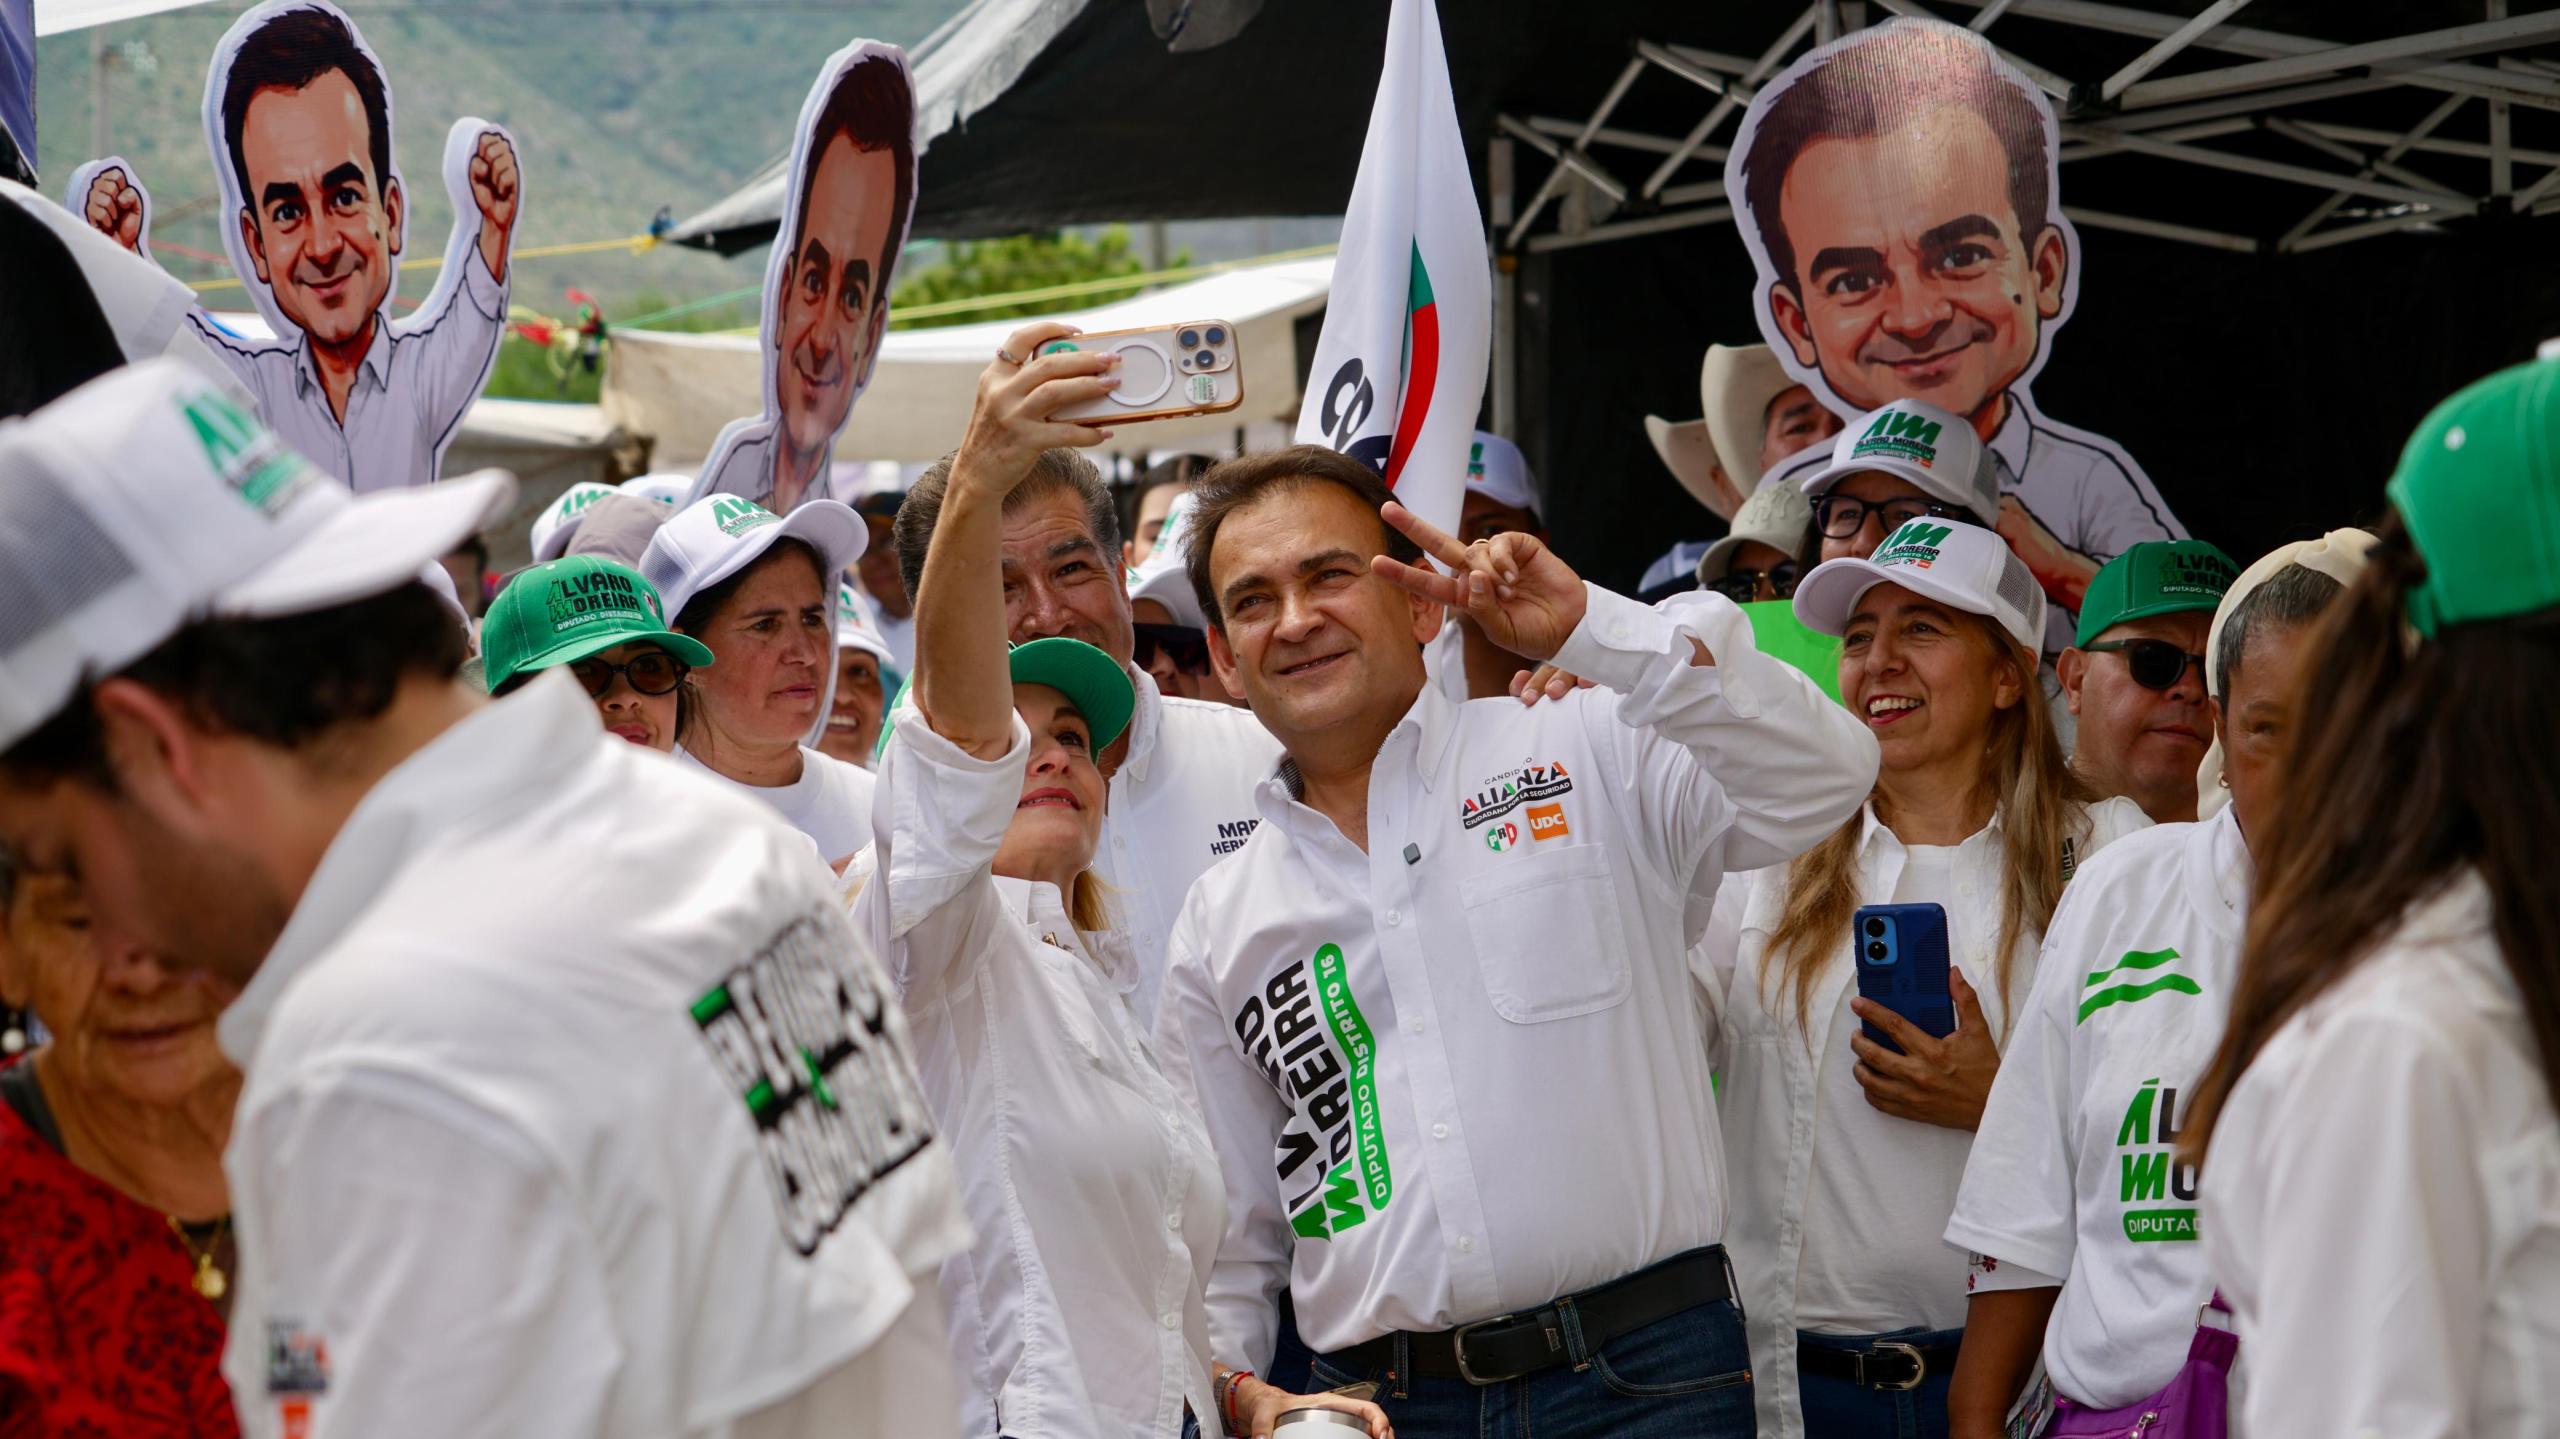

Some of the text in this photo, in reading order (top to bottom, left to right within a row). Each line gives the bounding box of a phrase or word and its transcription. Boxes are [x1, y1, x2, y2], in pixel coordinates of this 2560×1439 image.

[1890, 443, 1923, 456] DISTRITO
[1893, 436, 1937, 456] MOREIRA
[1893, 545, 1941, 557] MOREIRA
[549, 591, 641, 623] MOREIRA
[557, 613, 597, 631] DIPUTADO
[1462, 761, 1569, 817] ALIANZA
[1465, 806, 1508, 827] CIUDADANA
[1520, 791, 1530, 799] LA
[1529, 781, 1570, 798] SEGURIDAD
[1530, 813, 1565, 831] UDC
[1488, 826, 1515, 848] PRI
[1319, 954, 1388, 1200] DIPUTADO DISTRITO 16
[1266, 959, 1367, 1234] MOREIRA
[2128, 1216, 2204, 1234] DIPUTAD
